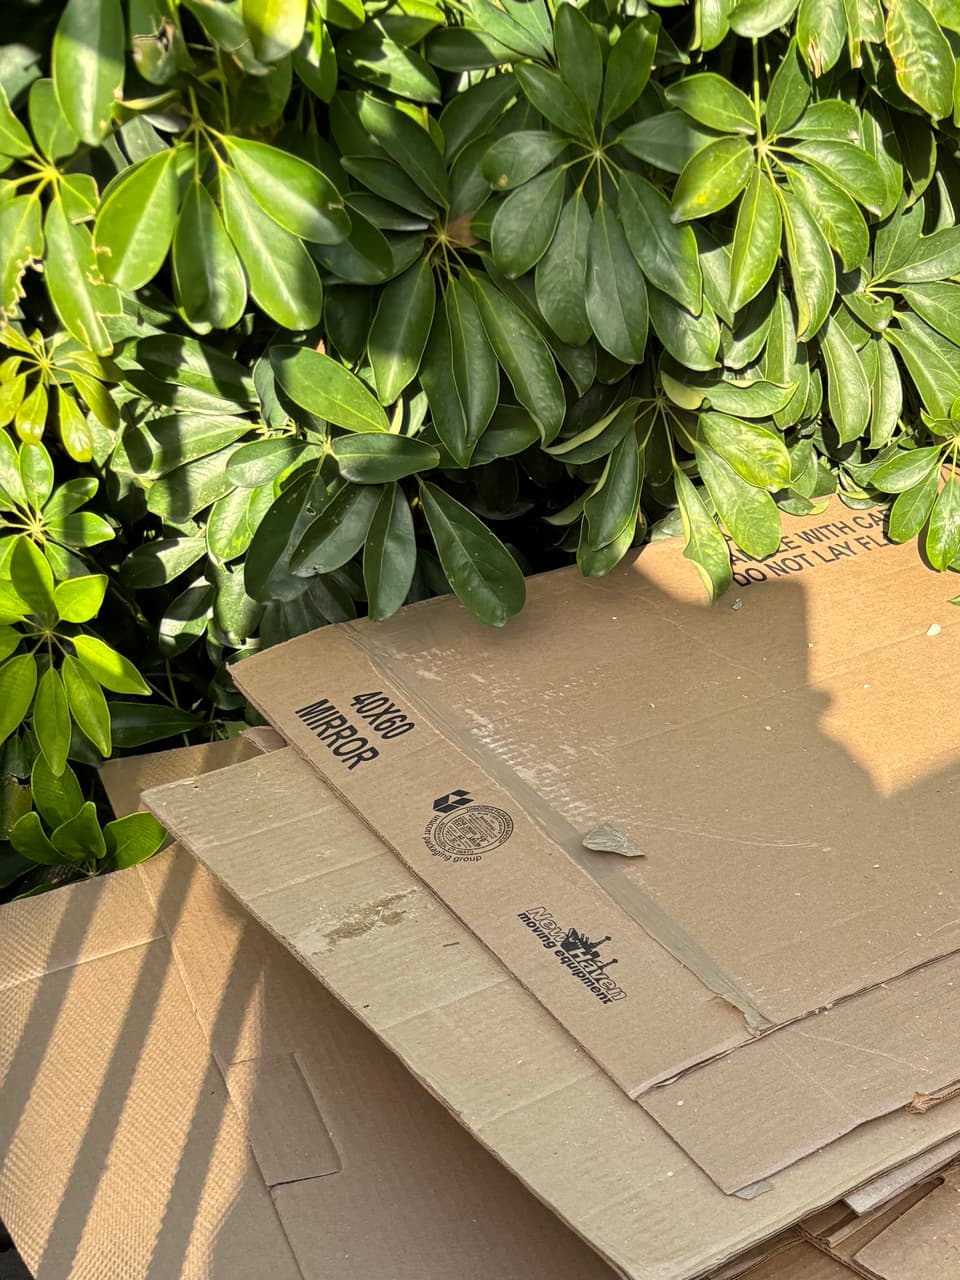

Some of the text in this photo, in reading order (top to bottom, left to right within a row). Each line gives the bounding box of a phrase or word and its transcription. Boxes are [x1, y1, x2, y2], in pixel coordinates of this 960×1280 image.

[794, 520, 857, 545] WITH
[733, 535, 890, 587] DO NOT LAY FL
[295, 698, 380, 770] MIRROR
[350, 691, 416, 740] 40X60
[421, 835, 452, 862] packaging
[452, 854, 482, 863] group
[517, 911, 613, 1005] moving equipment
[526, 906, 628, 1001] New Haven
